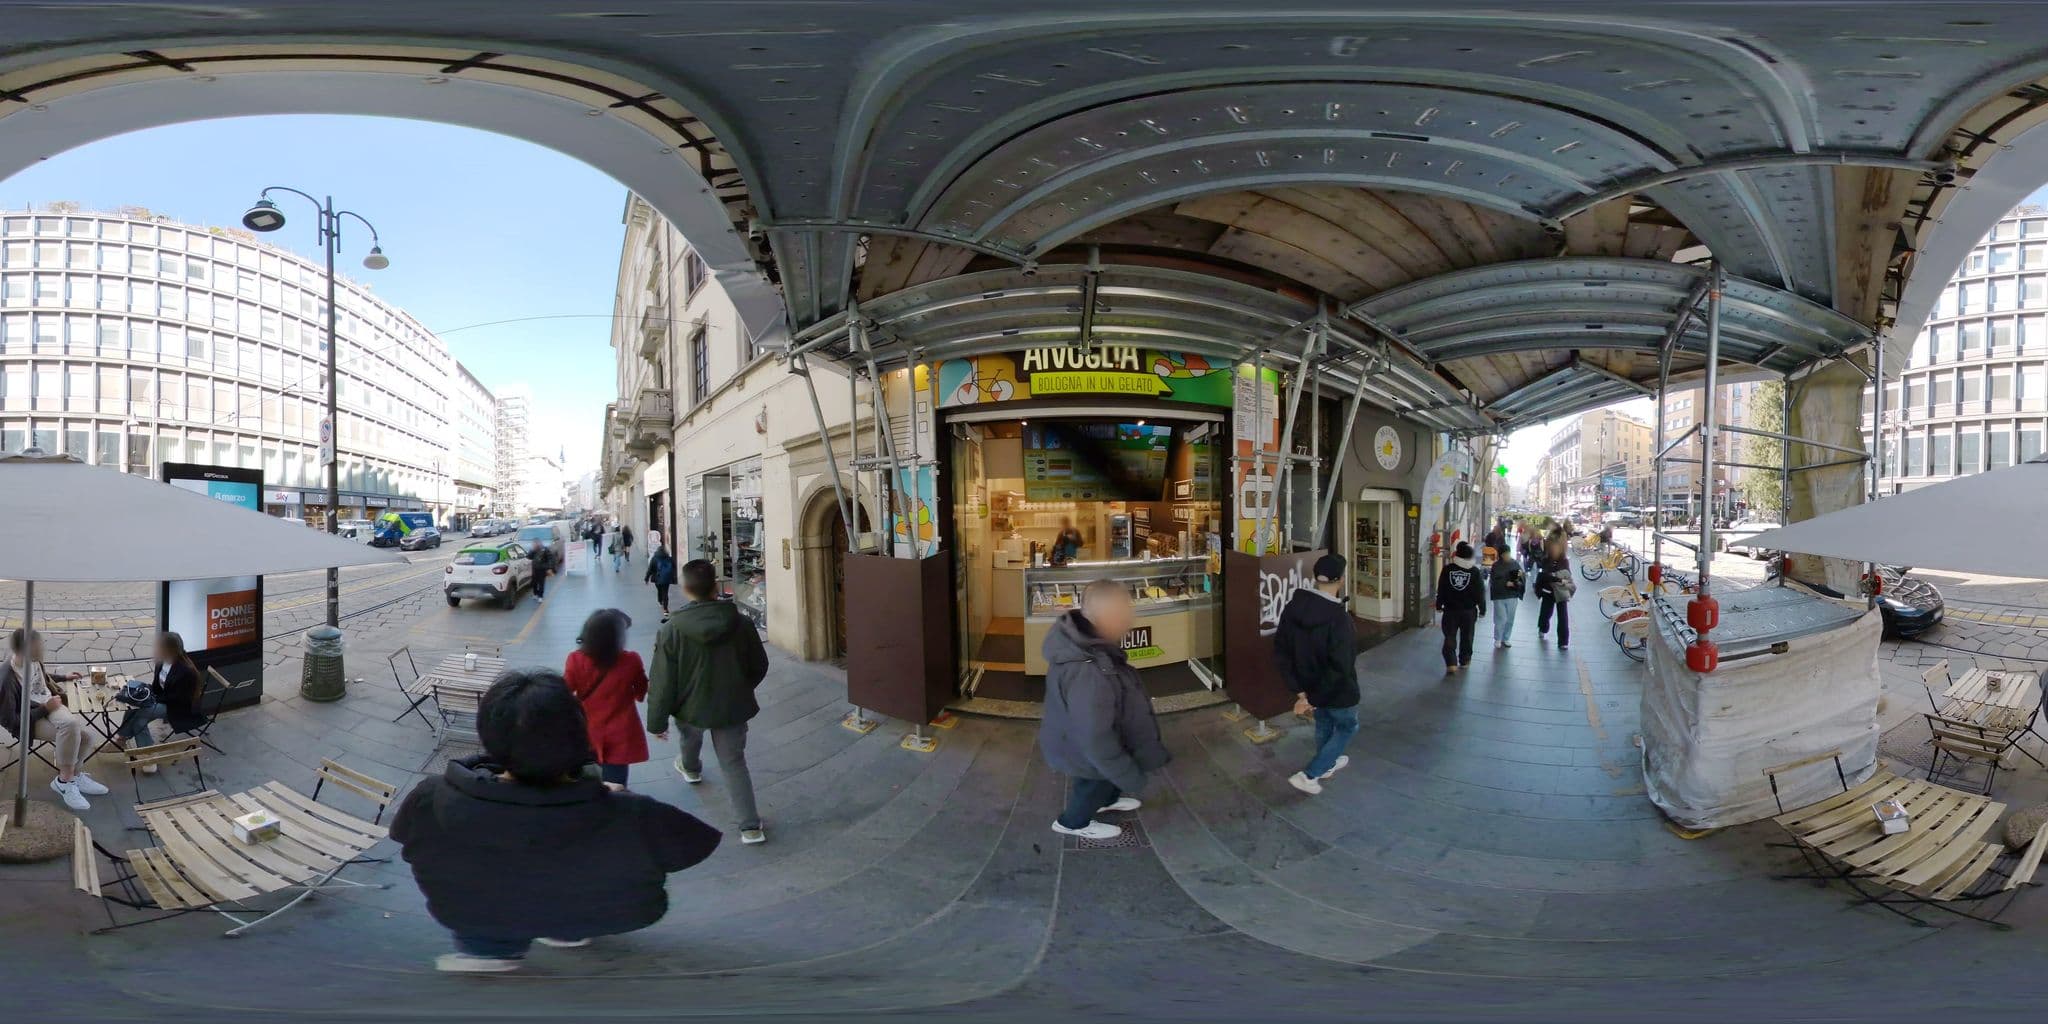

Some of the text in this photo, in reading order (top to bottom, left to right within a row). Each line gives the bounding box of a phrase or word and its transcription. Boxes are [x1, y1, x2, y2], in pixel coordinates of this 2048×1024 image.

[1038, 376, 1153, 392] BOLOGNA IN UN GELATO
[1296, 445, 1307, 456] 77
[276, 493, 289, 502] sky
[211, 603, 255, 619] DONNE
[211, 622, 218, 630] e
